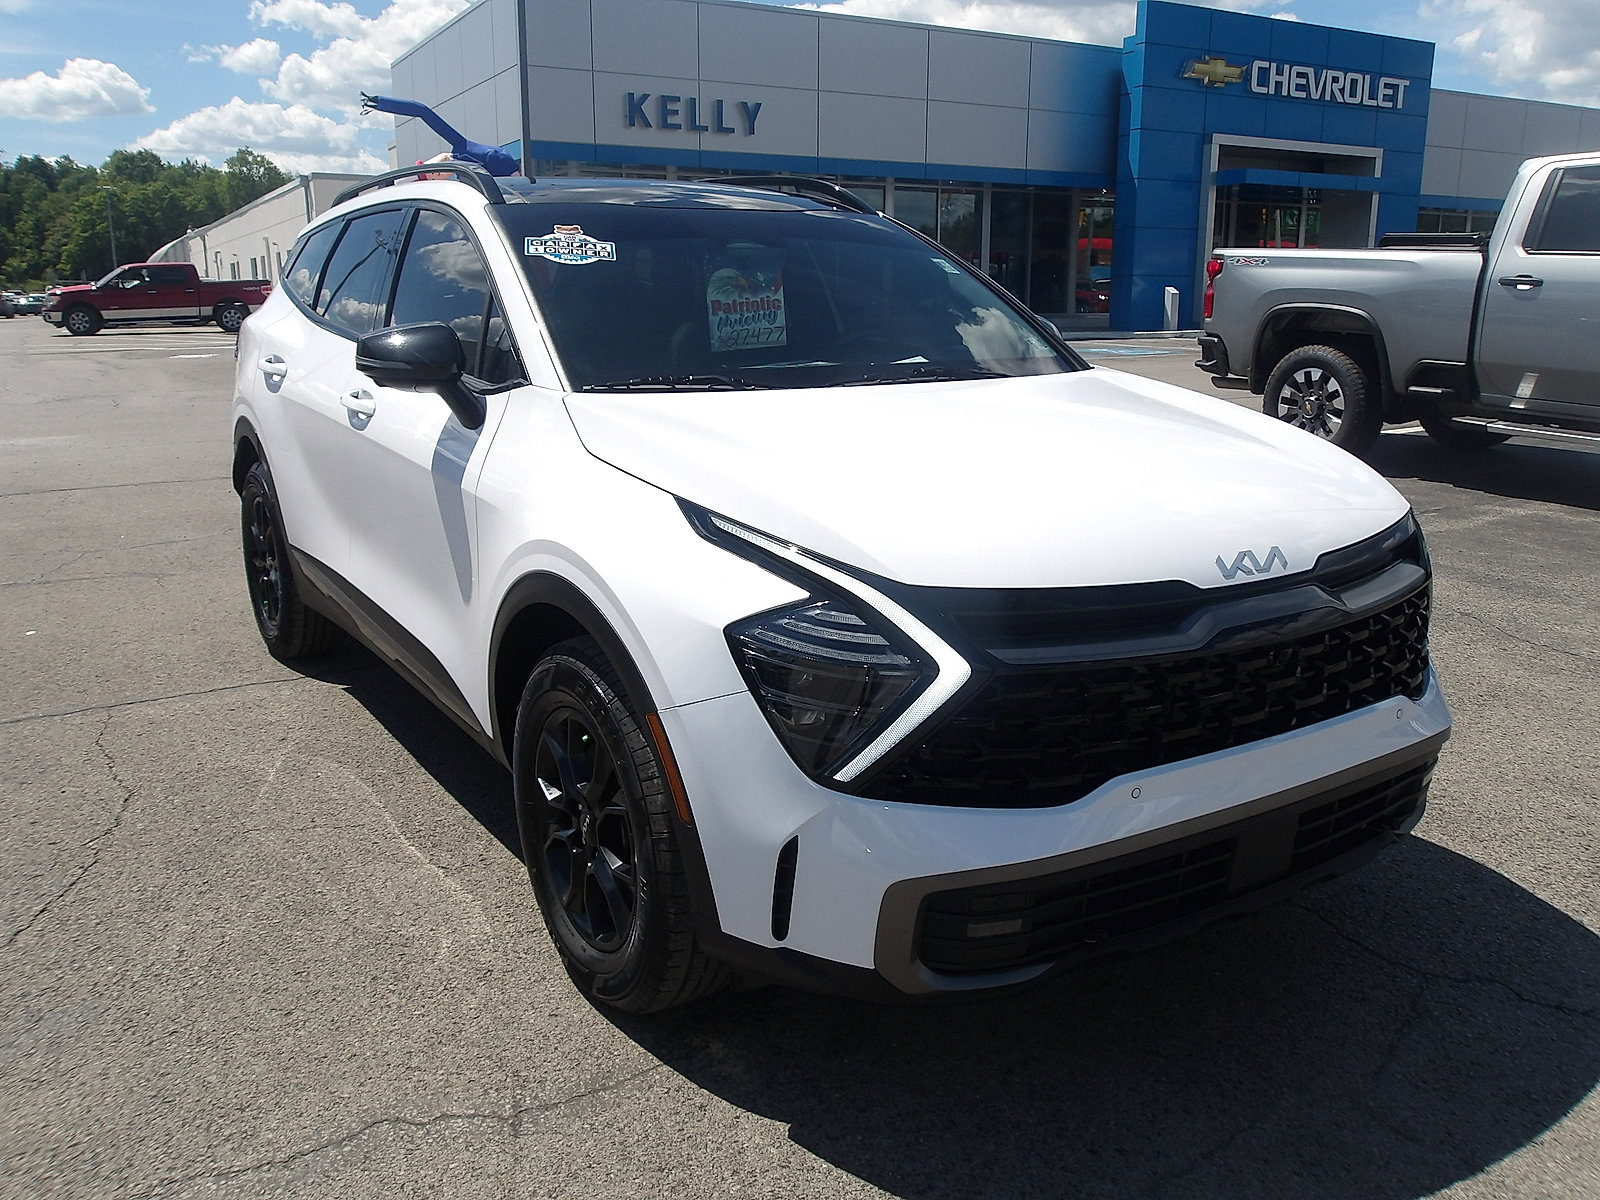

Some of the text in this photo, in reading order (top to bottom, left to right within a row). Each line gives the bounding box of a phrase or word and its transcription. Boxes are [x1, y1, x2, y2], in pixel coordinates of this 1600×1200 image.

[1251, 59, 1410, 109] CHEVROLET
[626, 91, 763, 135] KELLY
[531, 240, 608, 251] CARFAX
[545, 248, 610, 257] OWNER
[711, 295, 783, 316] Patriotic
[1215, 545, 1289, 581] KIA
